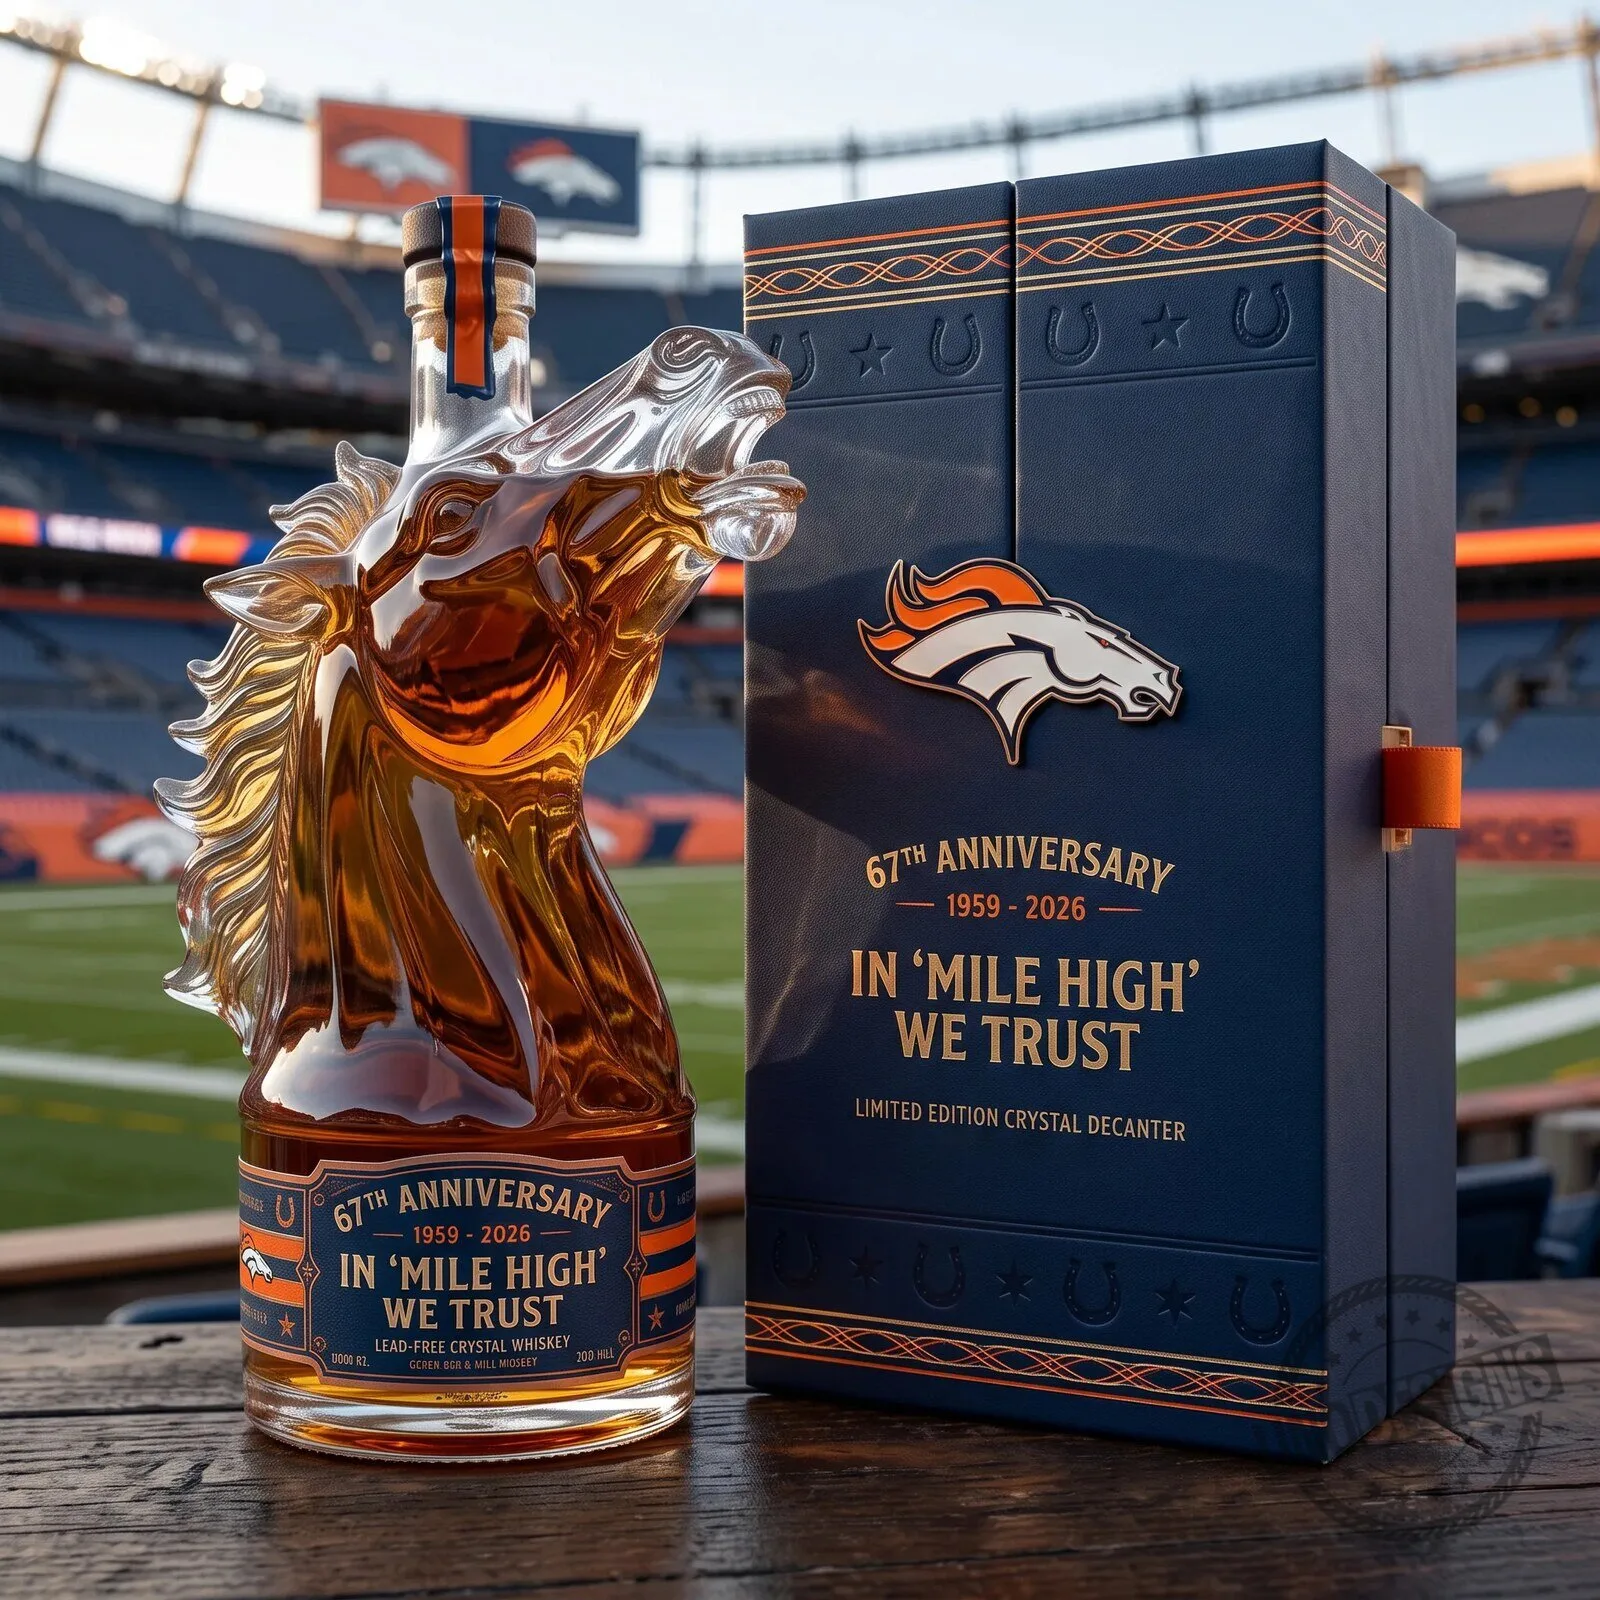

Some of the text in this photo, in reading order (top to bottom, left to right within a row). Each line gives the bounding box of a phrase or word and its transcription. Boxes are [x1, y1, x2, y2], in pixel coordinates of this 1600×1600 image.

[866, 836, 1176, 894] 67TH ANNIVERSARY
[947, 893, 1001, 918] 1959
[1025, 895, 1086, 921] 2026
[850, 949, 897, 998] IN
[895, 1011, 1141, 1071] WE TRUST
[855, 1098, 1186, 1142] LIMITED EDITION CRYSTAL DECANTER
[334, 1178, 613, 1232] 67TH ANNIVERSARY
[413, 1225, 459, 1244] 1959
[481, 1224, 531, 1243] 2026
[340, 1253, 376, 1288] IN
[382, 1295, 564, 1330] WE TRUST
[375, 1333, 571, 1354] LEAD-FREE CRYSTAL WHISKEY
[464, 1360, 472, 1370] &
[474, 1360, 497, 1370] MILL
